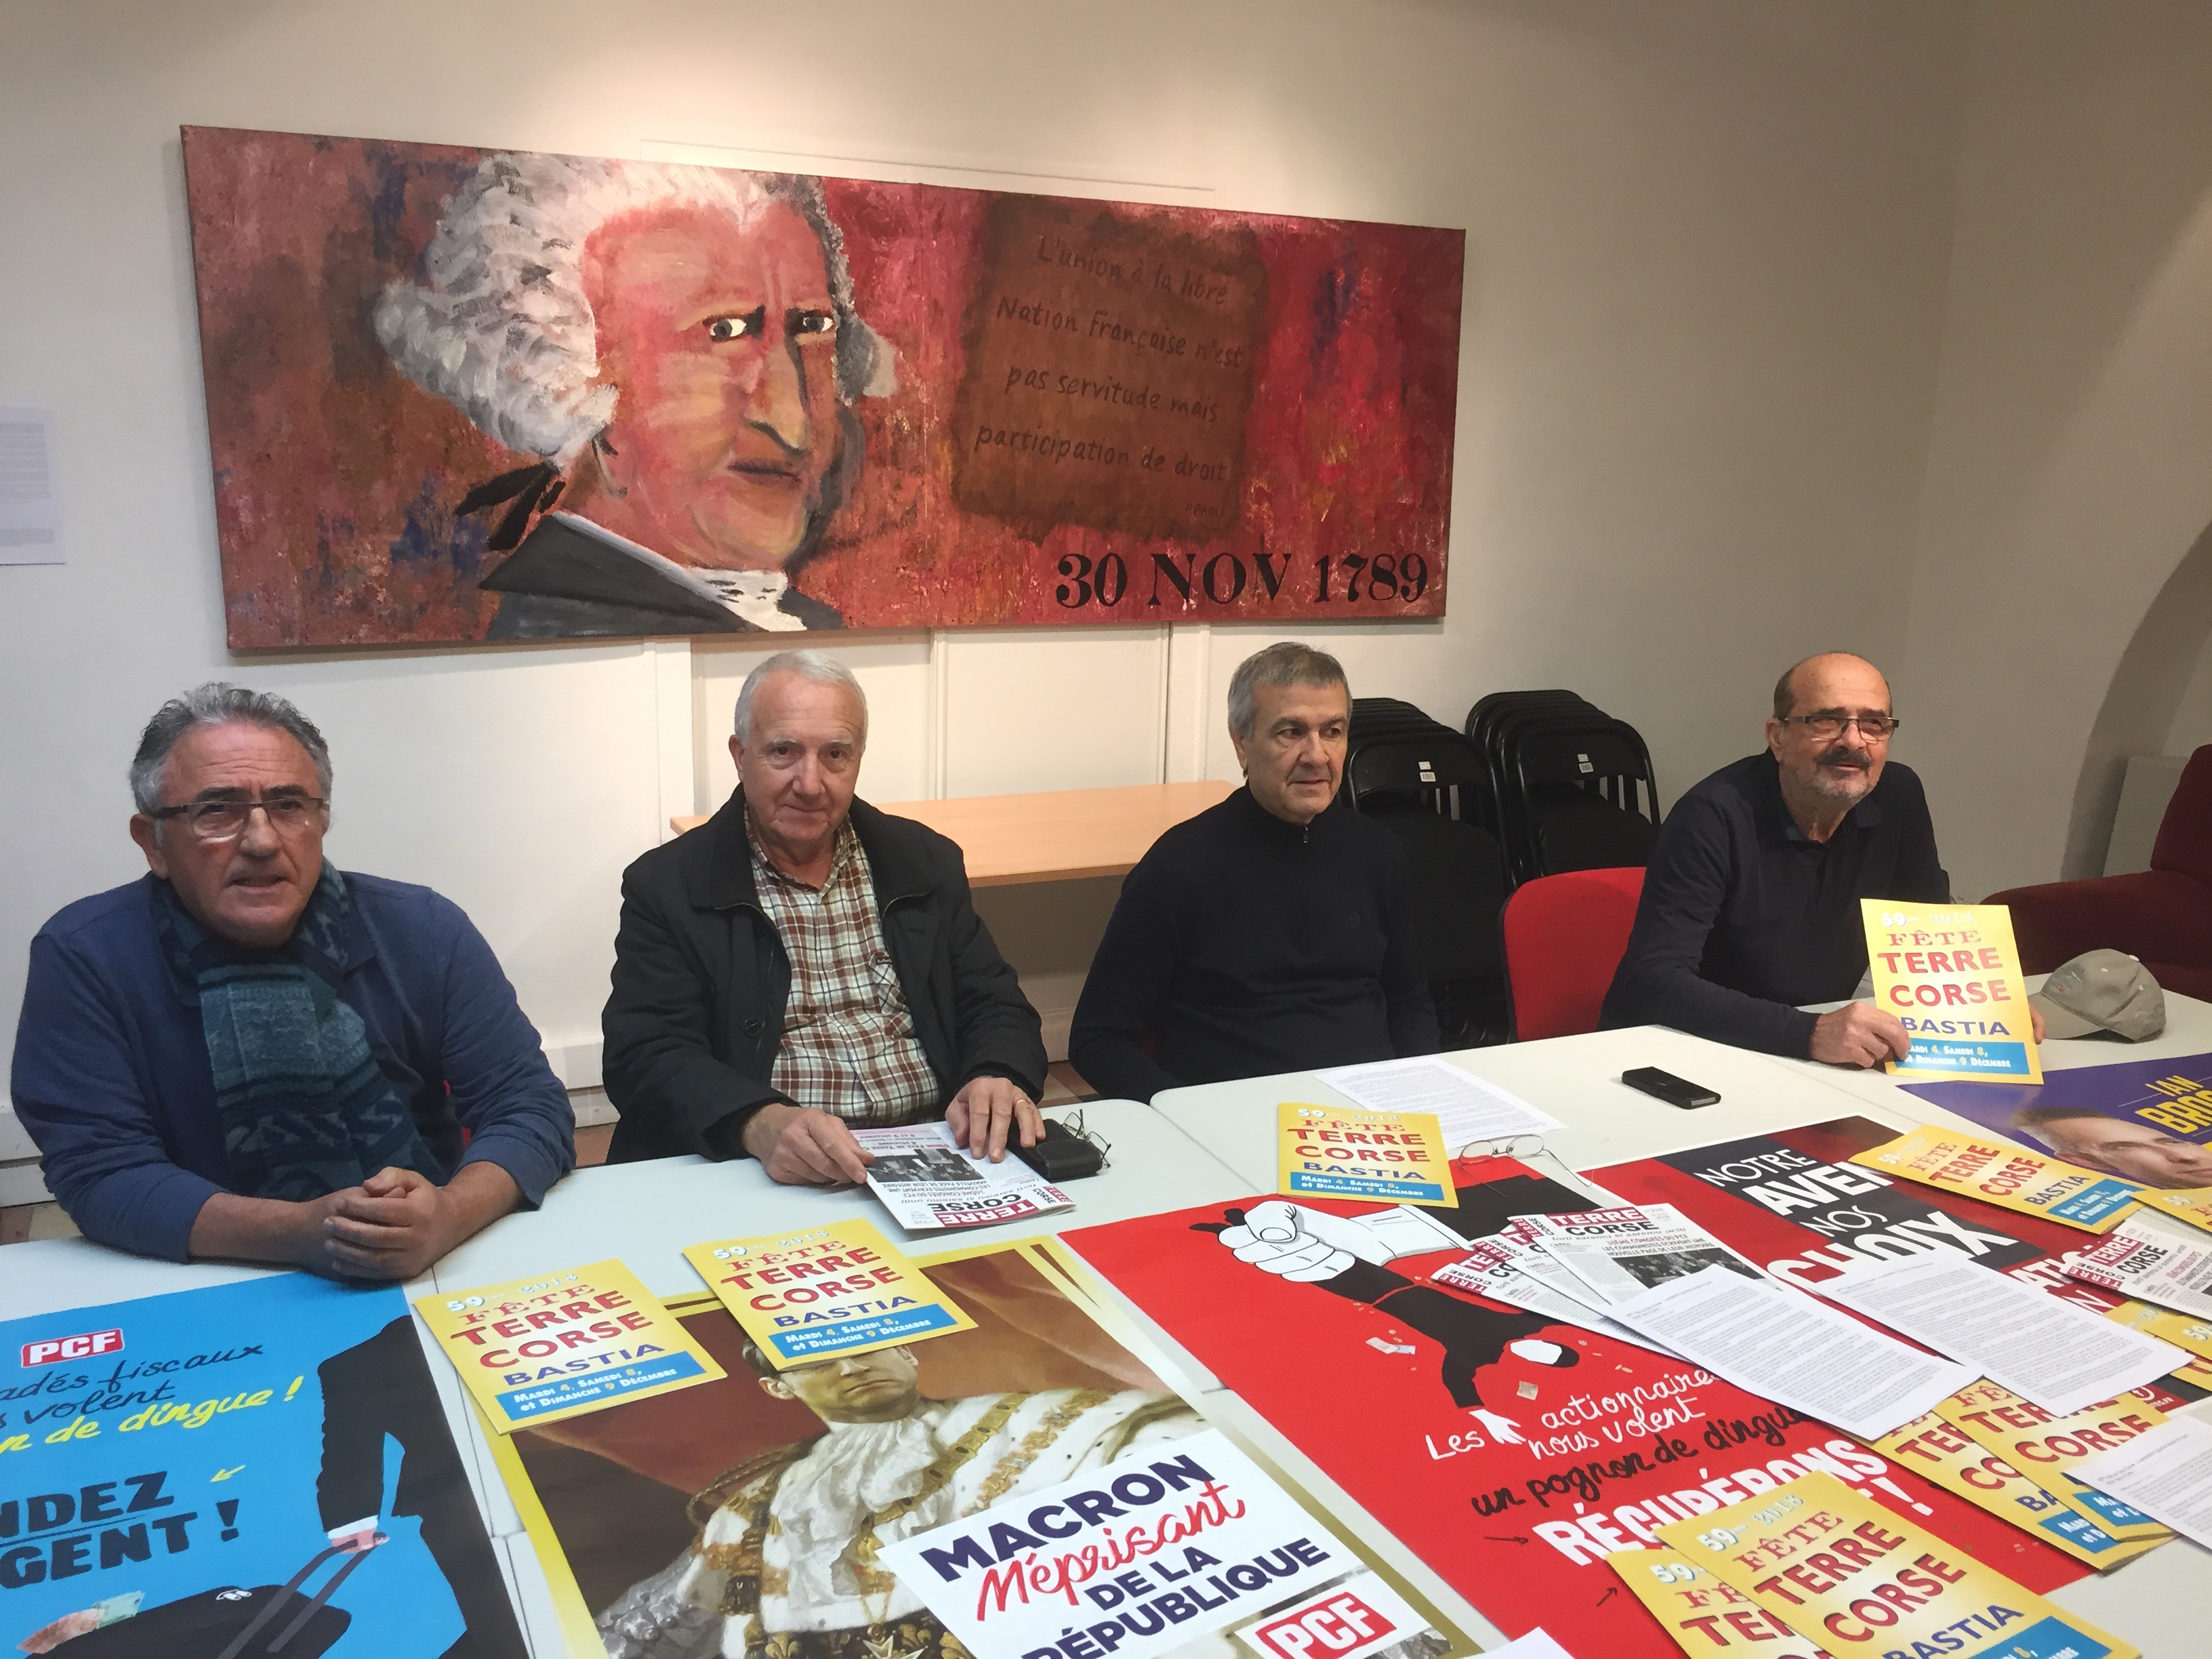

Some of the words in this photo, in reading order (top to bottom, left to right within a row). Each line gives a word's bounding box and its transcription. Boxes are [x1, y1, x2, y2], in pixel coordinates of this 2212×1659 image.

[1038, 237, 1122, 279] L'union
[1131, 258, 1145, 281] à
[1155, 265, 1172, 293] la
[1182, 270, 1228, 304] libre
[997, 298, 1078, 333] Nation
[1088, 310, 1186, 356] Française
[1195, 341, 1244, 367] n'est
[1005, 365, 1049, 393] pas
[1057, 372, 1160, 410] servitude
[1171, 396, 1218, 423] mais
[975, 424, 1130, 466] participation
[1141, 447, 1165, 473] de
[1175, 455, 1225, 482] droit
[1057, 553, 1128, 608] 30
[1148, 552, 1292, 606] NOV
[1313, 553, 1427, 602] 1789
[1886, 930, 1981, 946] FÊTE
[1877, 947, 2003, 973] TERRE
[1890, 979, 2011, 1007] CORSE
[1900, 1017, 2011, 1036] BASTIA
[1960, 1057, 1967, 1065] 9
[2145, 1075, 2204, 1097] IAN
[1287, 1129, 1426, 1145] TERRE
[1302, 1119, 1406, 1132] FÊTE
[1295, 1145, 1431, 1162] CORSE
[1303, 1162, 1426, 1180] BASTIA
[1694, 1149, 1818, 1187] NOTRE
[1907, 1143, 1958, 1172] FÊTE
[1929, 1145, 2001, 1183] TERRE
[1980, 1157, 2046, 1196] CORSE
[2024, 1175, 2091, 1206] BASTIA
[927, 1194, 1021, 1212] CORSE
[937, 1203, 1035, 1225] TERRE
[1551, 1209, 1643, 1225] TERRE
[1528, 1218, 1554, 1235] CORSE
[1565, 1221, 1659, 1235] CORSE
[1799, 1205, 1887, 1237] NOS
[725, 1240, 846, 1271] FÊTE
[1475, 1241, 1513, 1261] TERRE
[1489, 1239, 1523, 1256] CORSE
[2085, 1236, 2139, 1264] TERRE
[2117, 1245, 2169, 1274] CORSE
[720, 1246, 881, 1290] TERRE
[1440, 1273, 1485, 1293] TERRE
[1449, 1269, 1492, 1285] CORSE
[2069, 1267, 2123, 1288] TERRE
[458, 1284, 596, 1326] FÊTE
[750, 1267, 904, 1311] CORSE
[450, 1290, 632, 1346] TERRE
[773, 1295, 918, 1328] BASTIA
[30, 1332, 116, 1364] PCF
[479, 1311, 654, 1368] CORSE
[97, 1344, 264, 1393] fiscaux
[504, 1343, 665, 1385] BASTIA
[24, 1379, 176, 1424] volent
[45, 1415, 101, 1443] de
[119, 1389, 274, 1433] dingue
[1541, 1370, 1718, 1429] actionnaire
[1426, 1431, 1485, 1460] Les
[1528, 1431, 1600, 1460] nous
[1602, 1396, 1706, 1444] volent
[2015, 1414, 2153, 1462] CORSE
[1471, 1487, 1526, 1517] un
[1526, 1452, 1656, 1508] pognon
[1654, 1433, 1698, 1464] de
[918, 1454, 1216, 1582] MACRON
[1752, 1494, 1804, 1525] 2018
[0, 1512, 198, 1589] GENT
[216, 1498, 239, 1542] !
[977, 1480, 1246, 1622] Méprisant
[1732, 1511, 1844, 1572] FÊTE
[1084, 1570, 1157, 1612] DE
[1147, 1546, 1223, 1582] LA
[1753, 1520, 1906, 1606] TERRE
[1824, 1554, 1967, 1642] CORSE
[1267, 1597, 1375, 1659] PCF
[1883, 1605, 2025, 1659] BASTIA
